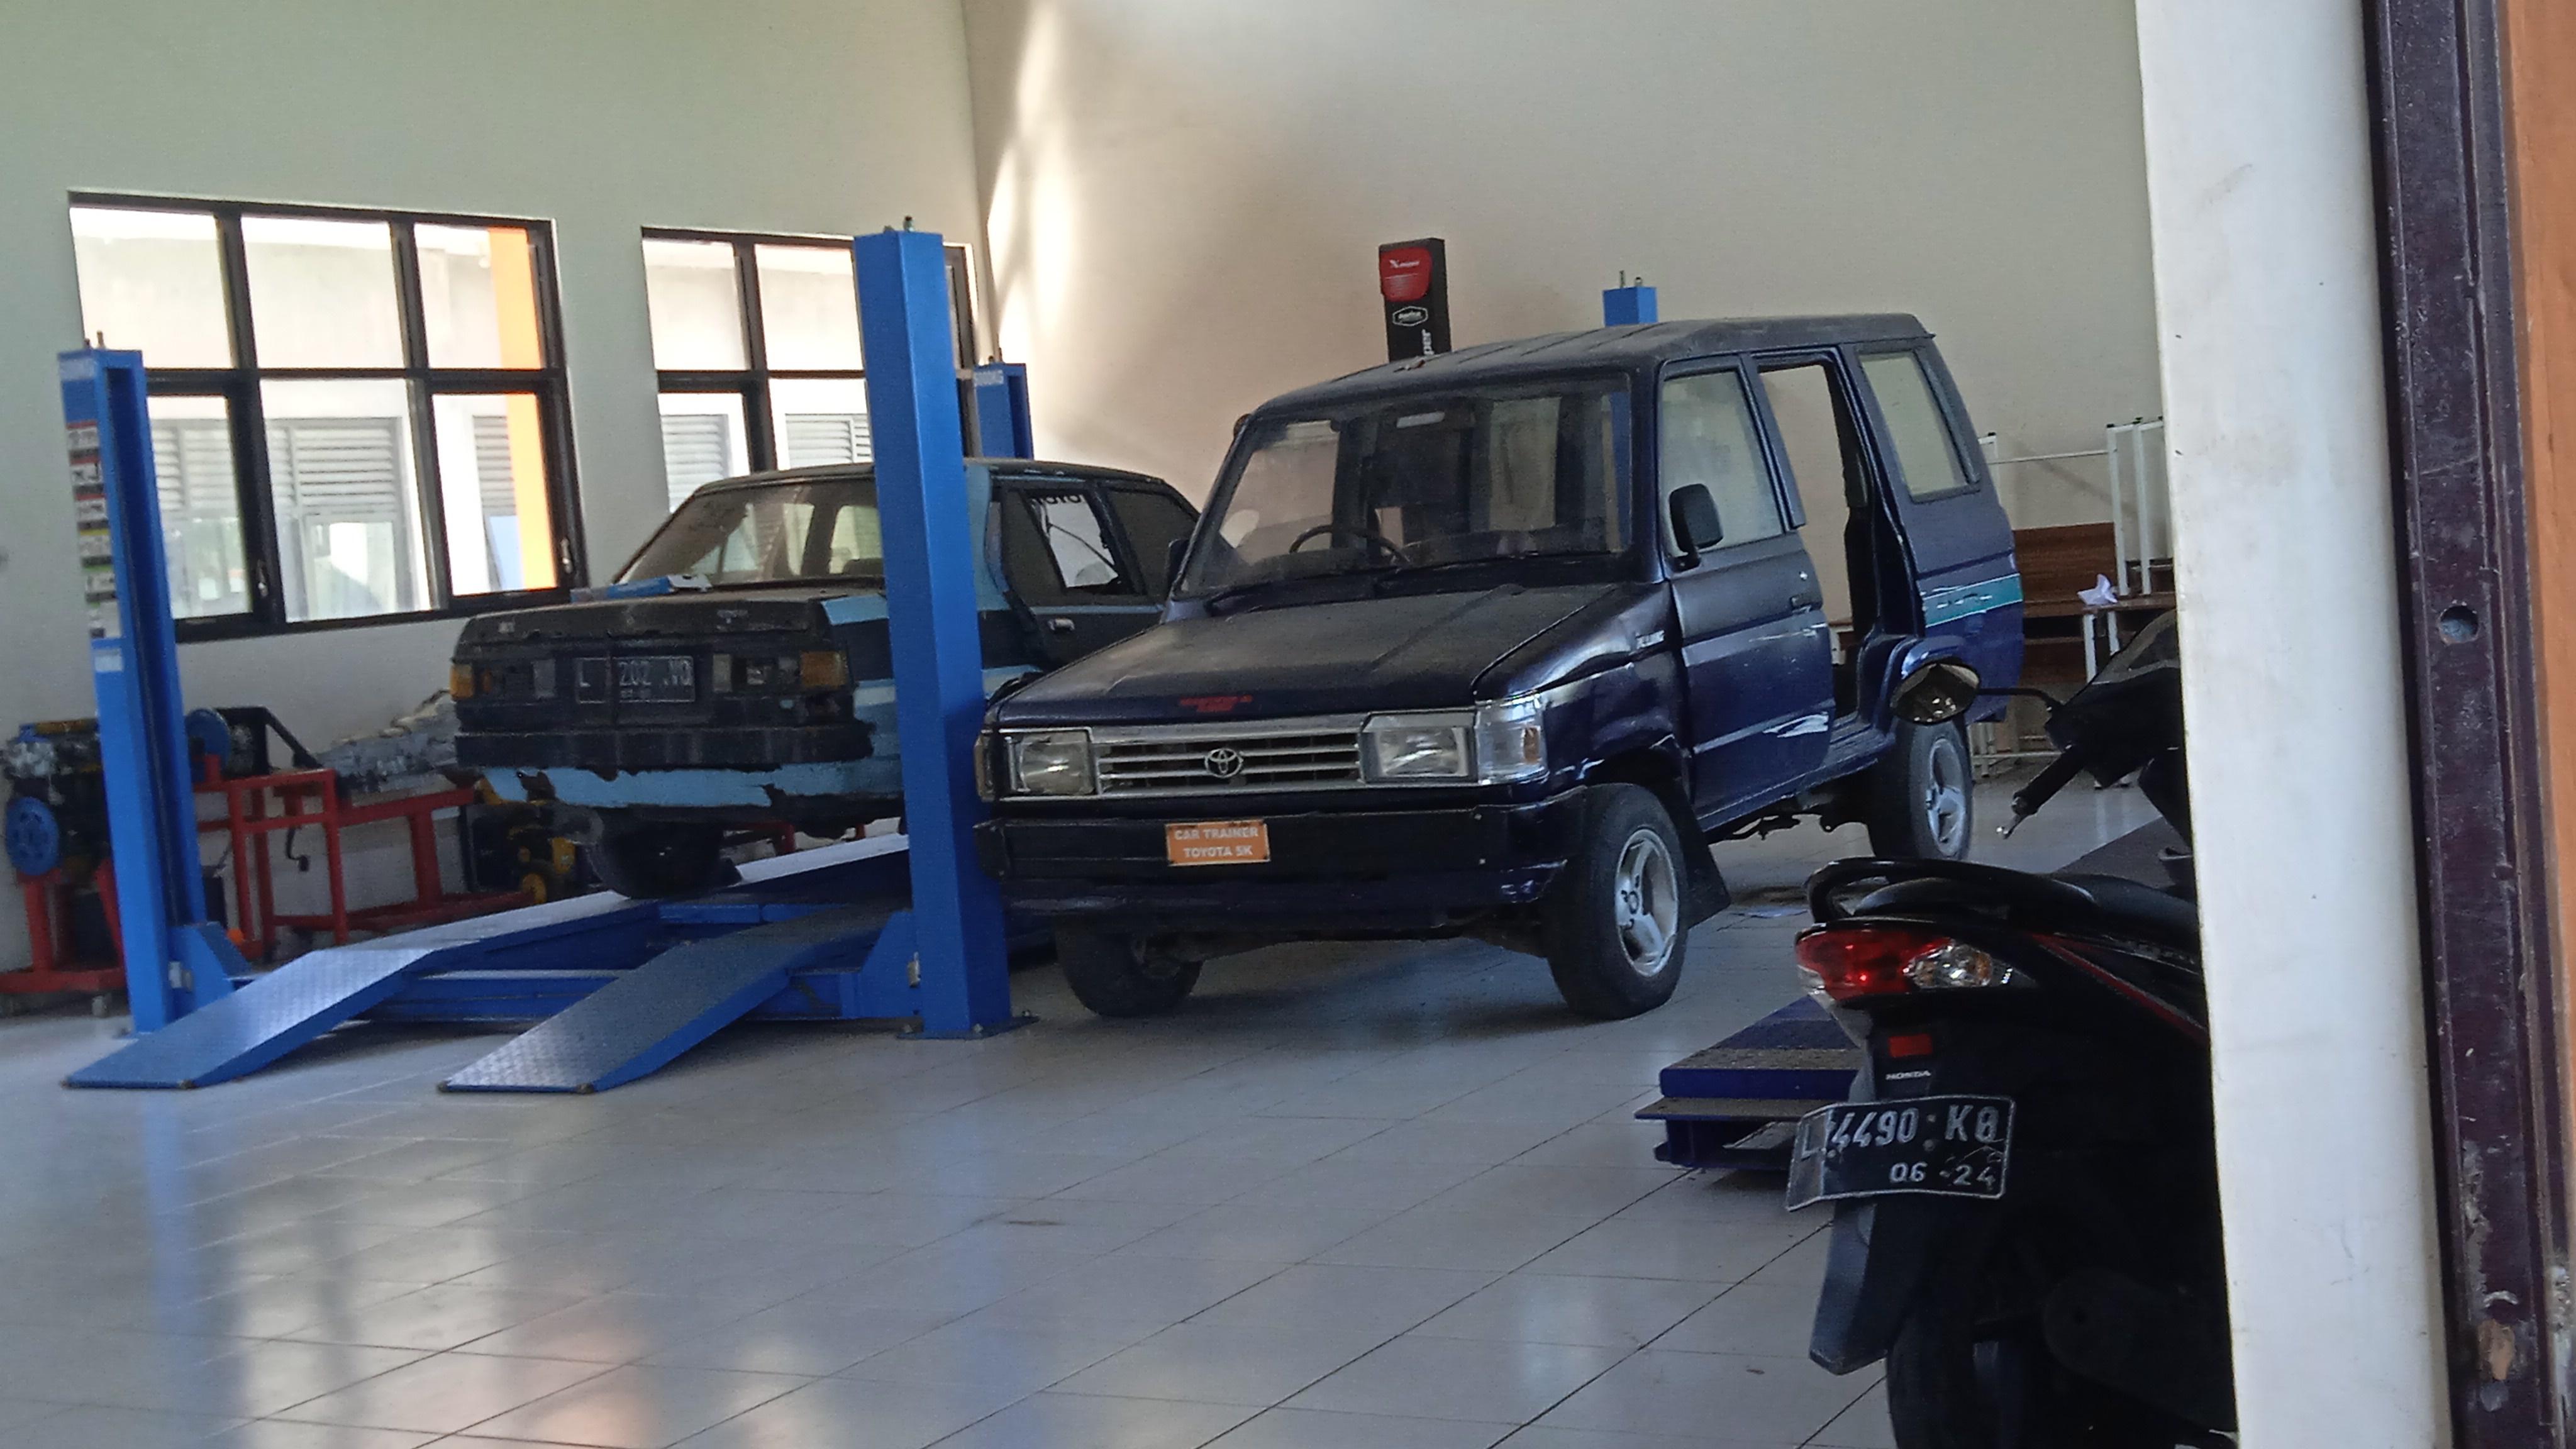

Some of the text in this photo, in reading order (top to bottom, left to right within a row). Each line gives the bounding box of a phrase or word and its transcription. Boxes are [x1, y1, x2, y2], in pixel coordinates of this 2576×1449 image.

[1174, 827, 1258, 840] CAR TRAINER
[1183, 847, 1233, 858] TOYOTA
[1885, 1070, 1931, 1080] HONDA
